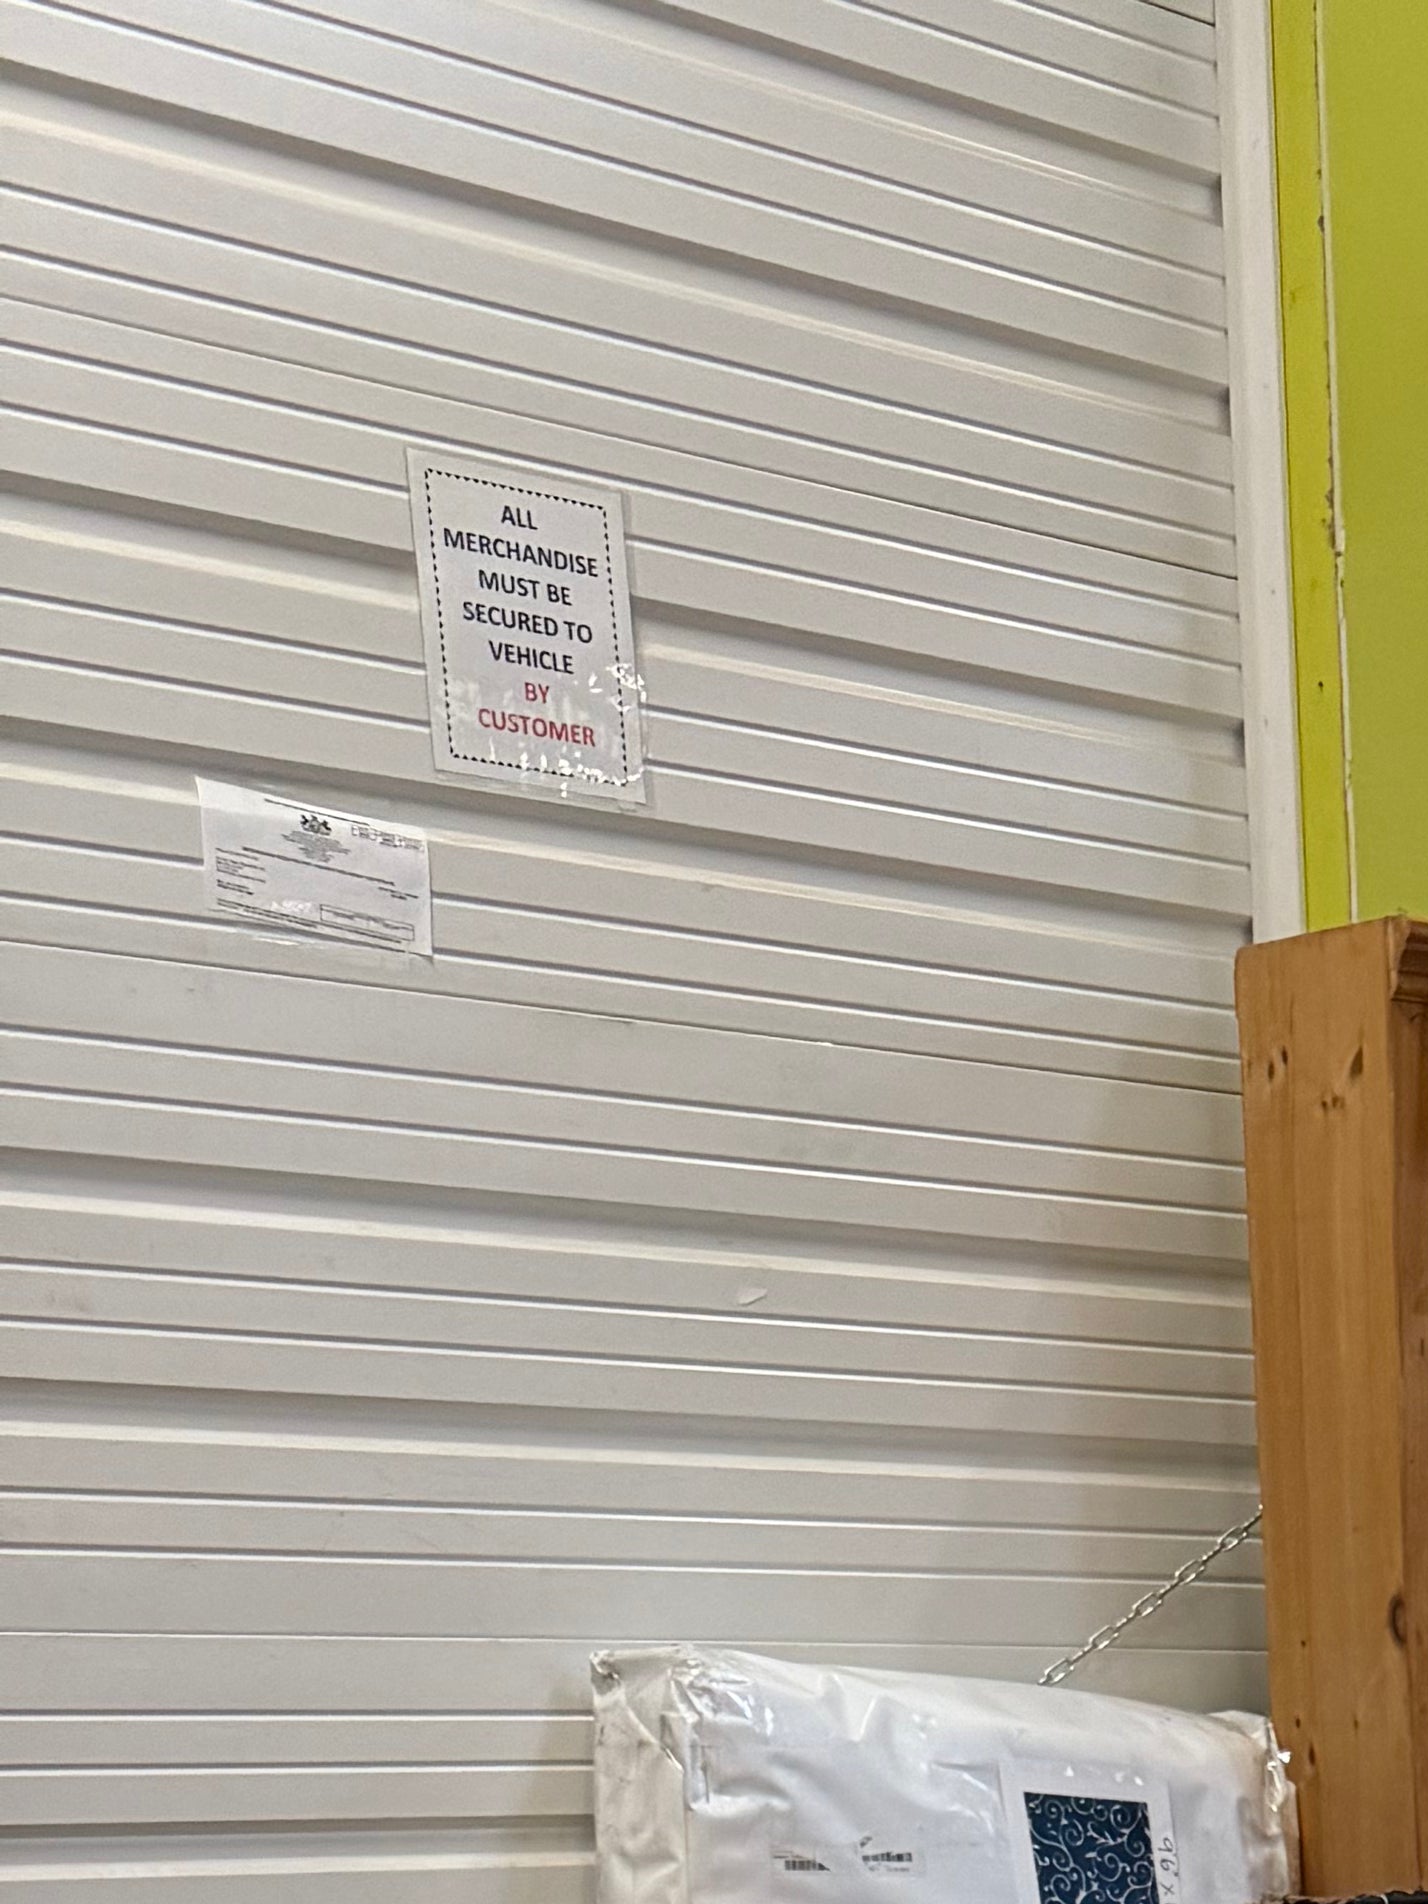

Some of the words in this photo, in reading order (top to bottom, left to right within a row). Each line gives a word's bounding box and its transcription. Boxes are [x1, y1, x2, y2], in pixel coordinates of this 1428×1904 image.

[500, 505, 538, 530] ALL
[443, 528, 598, 577] MERCHANDISE
[478, 570, 540, 600] MUST
[546, 582, 572, 606] BE
[462, 601, 558, 637] SECURED
[563, 621, 593, 643] TO
[488, 640, 575, 674] VEHICLE
[524, 681, 550, 704] BY
[478, 708, 595, 747] CUSTOMER
